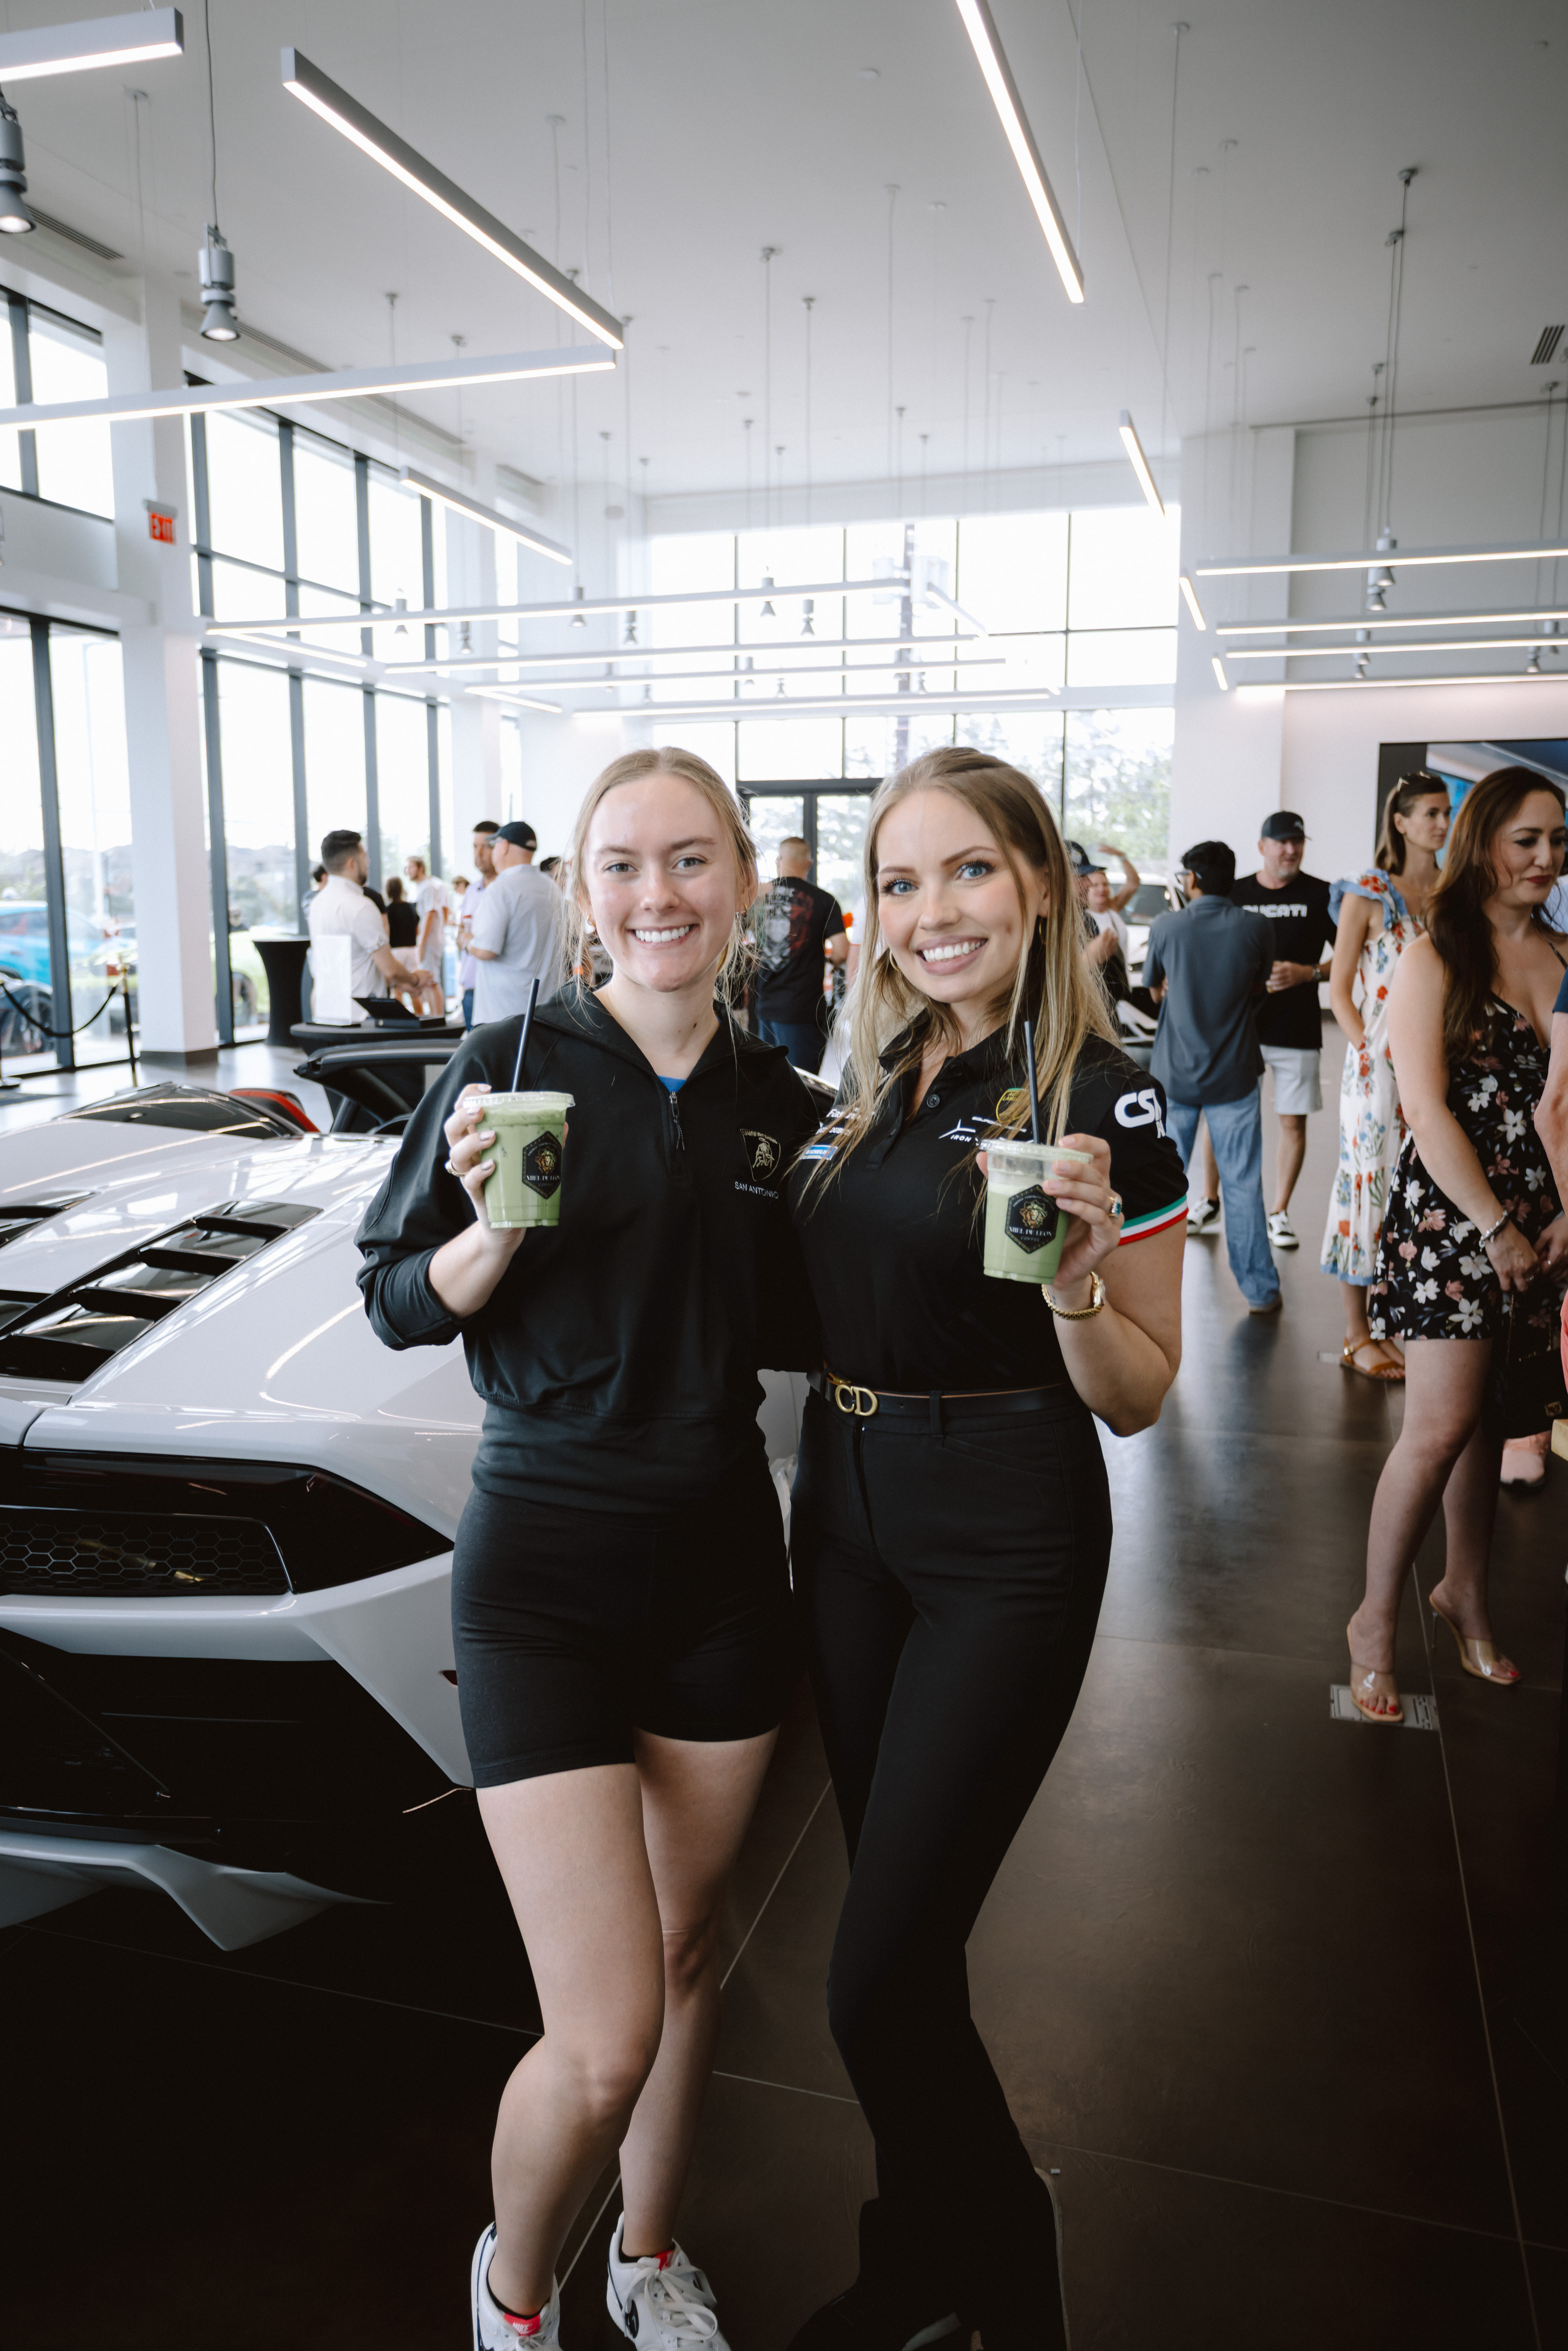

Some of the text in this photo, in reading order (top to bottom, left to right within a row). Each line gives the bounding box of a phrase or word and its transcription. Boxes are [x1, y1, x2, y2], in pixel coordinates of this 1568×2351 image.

[150, 513, 173, 544] EXIT
[950, 1134, 972, 1143] IRON
[735, 1181, 779, 1199] SAN ANTONIO
[512, 2322, 529, 2334] NIKE
